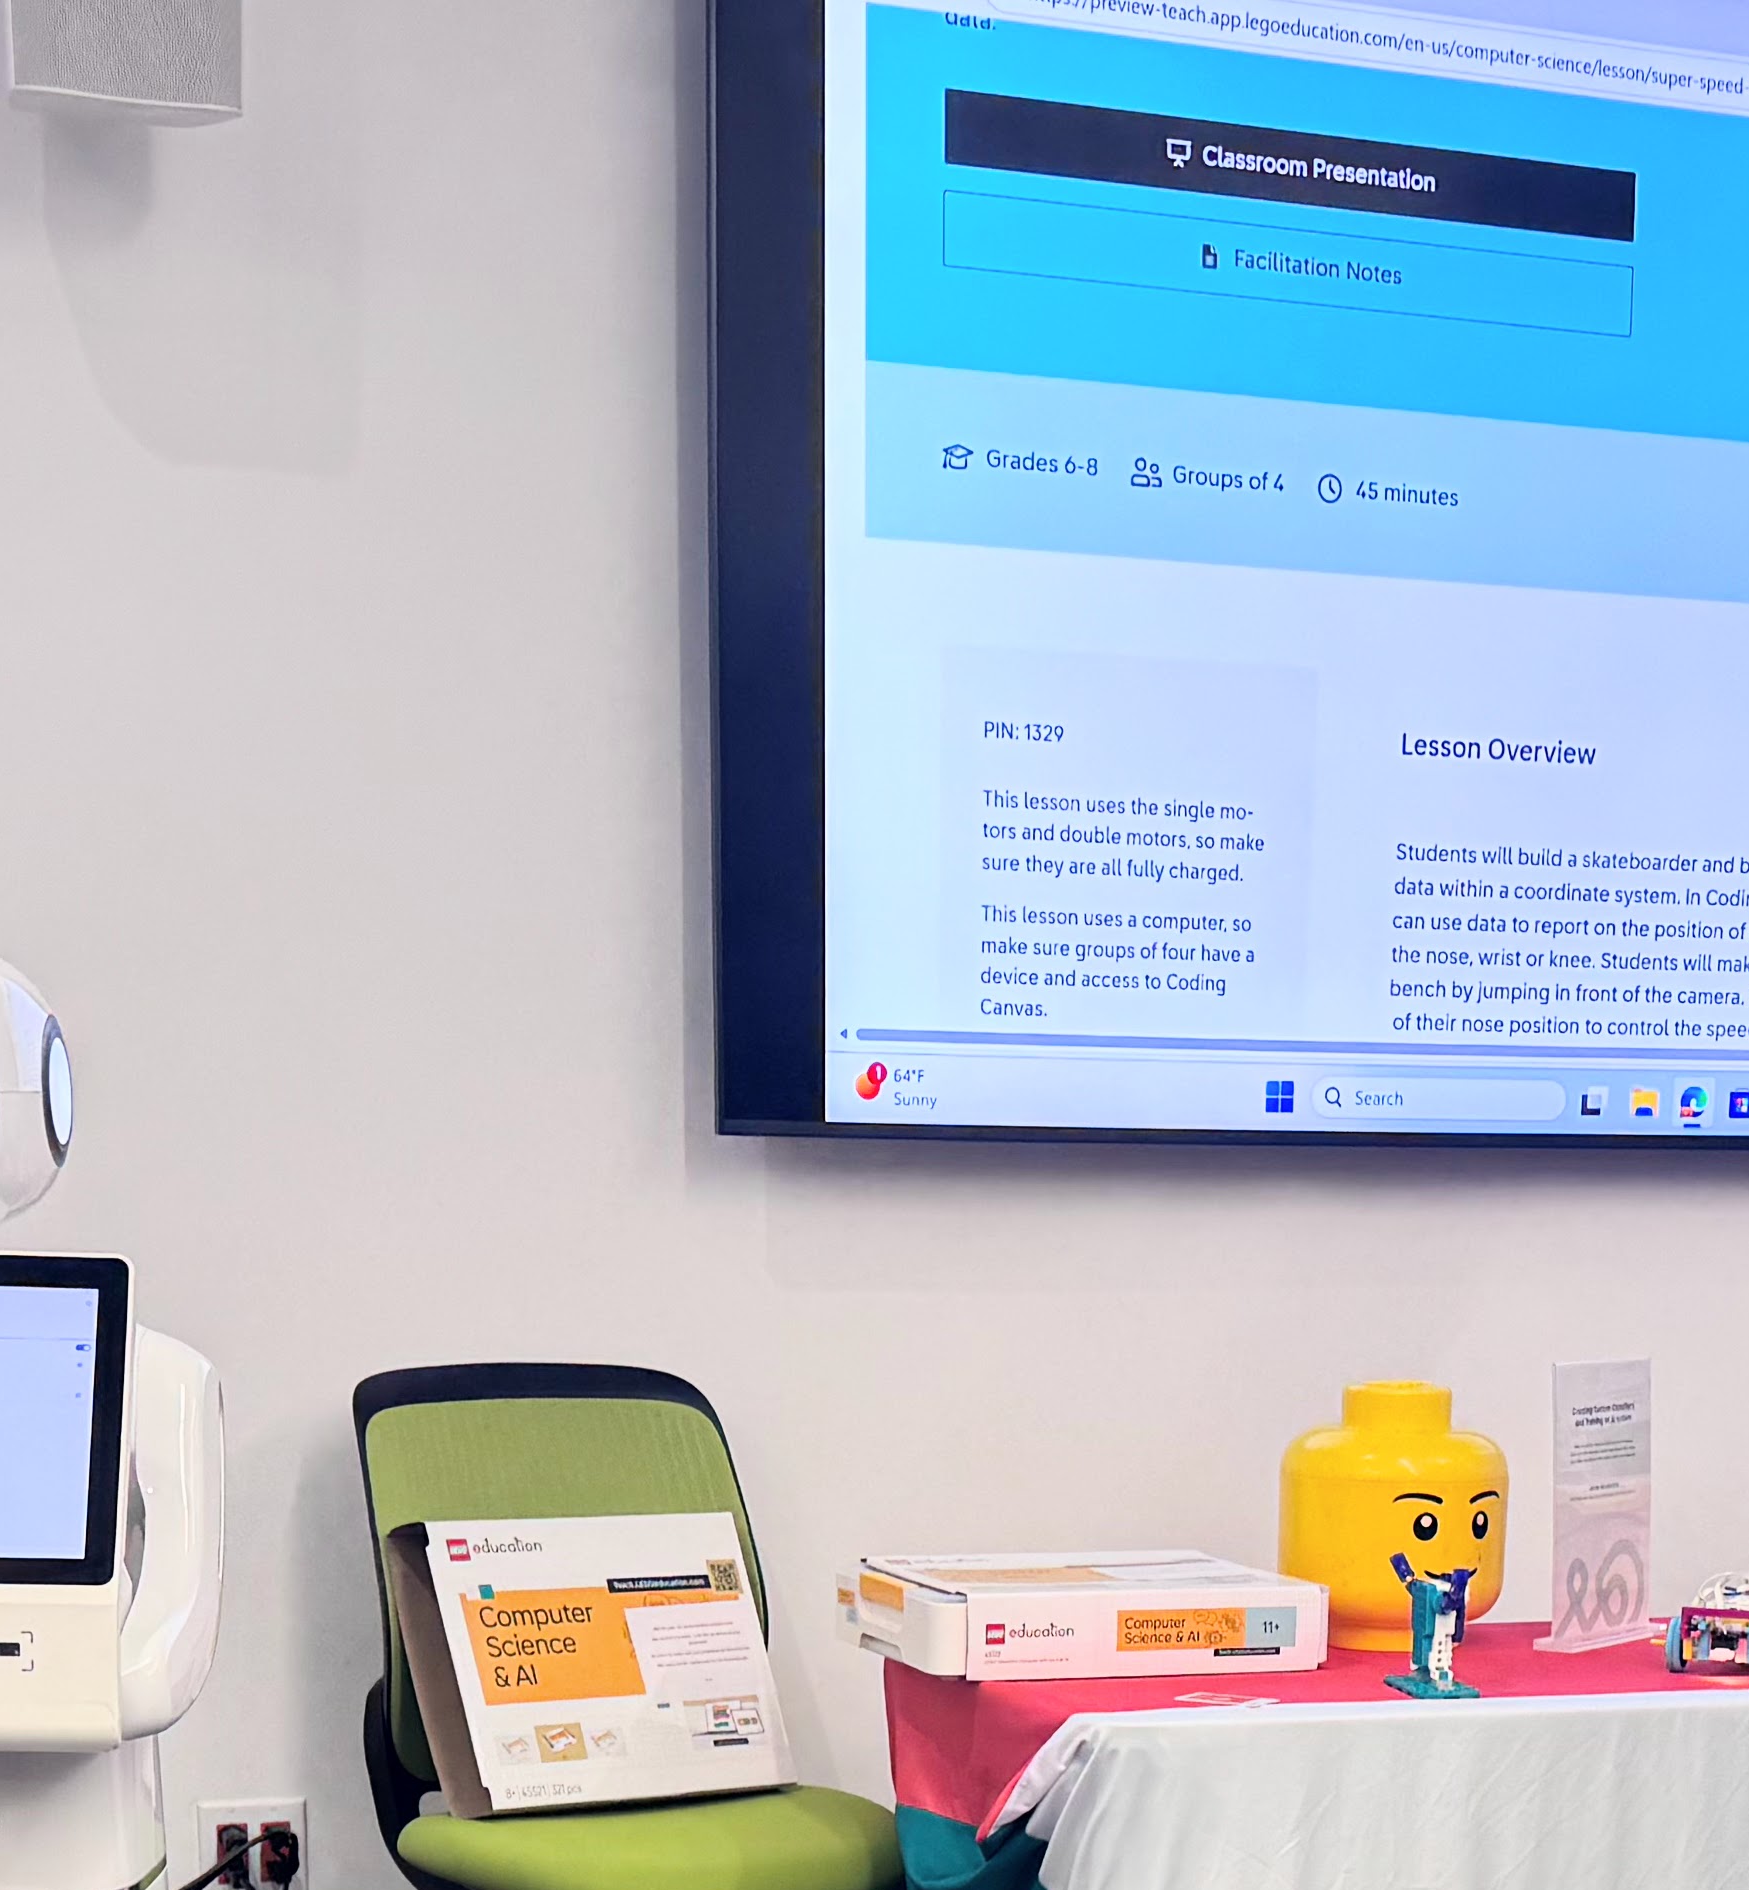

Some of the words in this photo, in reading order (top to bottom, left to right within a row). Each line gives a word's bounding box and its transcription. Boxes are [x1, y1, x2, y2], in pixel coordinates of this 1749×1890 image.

[1202, 145, 1308, 177] Classroom
[1312, 158, 1436, 192] Presentation
[1234, 249, 1340, 278] Facilitation
[1346, 260, 1402, 285] Notes
[986, 449, 1059, 473] Grades
[1064, 456, 1098, 476] 6-8
[1173, 465, 1243, 492] Groups
[1248, 472, 1269, 491] of
[1273, 474, 1284, 492] 4
[1356, 480, 1379, 500] 45
[1384, 483, 1459, 507] minutes
[984, 721, 1019, 740] PIN:
[1024, 723, 1064, 742] 1329
[1401, 732, 1481, 759] Lesson
[1488, 738, 1596, 765] Overview
[983, 789, 1019, 809] This
[1024, 791, 1081, 812] lesson
[1086, 799, 1126, 814] uses
[1131, 798, 1159, 815] the
[1164, 799, 1215, 822] single
[1220, 806, 1254, 821] mo-
[983, 823, 1017, 839] tors
[1021, 823, 1055, 841] and
[1059, 824, 1122, 845] double
[1126, 832, 1191, 850] motors,
[1195, 835, 1215, 849] so
[1220, 834, 1265, 851] make
[982, 857, 1020, 872] sure
[1025, 855, 1064, 879] they
[1068, 861, 1096, 875] are
[1101, 858, 1122, 877] all
[1127, 859, 1165, 882] fully
[1168, 862, 1244, 885] charged.
[1396, 842, 1477, 864] Students
[1481, 846, 1513, 865] will
[1518, 848, 1563, 867] build
[1567, 854, 1577, 867] a
[1582, 851, 1698, 872] skateboarder
[1702, 856, 1735, 874] and
[1394, 876, 1434, 896] data
[1439, 879, 1494, 898] within
[1499, 885, 1509, 899] a
[1514, 883, 1610, 903] coordinate
[1614, 888, 1681, 907] system.
[1685, 888, 1701, 906] In
[981, 904, 1017, 923] This
[1022, 906, 1079, 925] lesson
[1083, 913, 1123, 927] uses
[1127, 915, 1137, 928] a
[1142, 915, 1227, 934] computer,
[1232, 918, 1252, 932] so
[1392, 916, 1425, 929] can
[1430, 917, 1462, 930] use
[1467, 914, 1507, 933] data
[1512, 917, 1530, 933] to
[1534, 920, 1589, 938] report
[1593, 922, 1616, 936] on
[1621, 918, 1650, 937] the
[1654, 921, 1724, 942] position
[1728, 922, 1747, 939] of
[981, 936, 1028, 954] make
[1033, 942, 1070, 956] sure
[1075, 944, 1135, 963] groups
[1140, 942, 1158, 960] of
[1162, 942, 1196, 961] four
[1201, 944, 1241, 963] have
[1245, 950, 1255, 963] a
[1391, 945, 1421, 963] the
[1426, 950, 1473, 967] nose,
[1478, 951, 1521, 967] wrist
[1525, 953, 1545, 967] or
[1549, 949, 1596, 969] knee.
[1600, 952, 1678, 971] Students
[1683, 954, 1712, 971] will
[980, 966, 1039, 986] device
[1043, 969, 1076, 987] and
[1081, 974, 1139, 989] access
[1144, 974, 1162, 990] to
[1166, 973, 1226, 997] Coding
[1390, 979, 1446, 998] bench
[1452, 980, 1474, 1003] by
[1476, 981, 1550, 1005] jumping
[1555, 984, 1570, 1001] in
[1575, 983, 1618, 1003] front
[1622, 984, 1641, 1002] of
[1644, 986, 1673, 1004] the
[1677, 990, 1745, 1006] camera.
[980, 999, 1048, 1017] Canvas.
[894, 1091, 938, 1110] Sunny
[1355, 1091, 1404, 1106] Search
[472, 1536, 543, 1554] education
[479, 1604, 593, 1631] Computer
[1009, 1622, 1075, 1639] education
[1124, 1617, 1186, 1634] Computer
[1262, 1620, 1280, 1634] 11+
[486, 1633, 577, 1658] Science
[1124, 1631, 1172, 1645] Science
[1175, 1631, 1184, 1643] &
[1187, 1631, 1201, 1643] AI
[494, 1665, 511, 1687] &
[516, 1663, 538, 1687] AI
